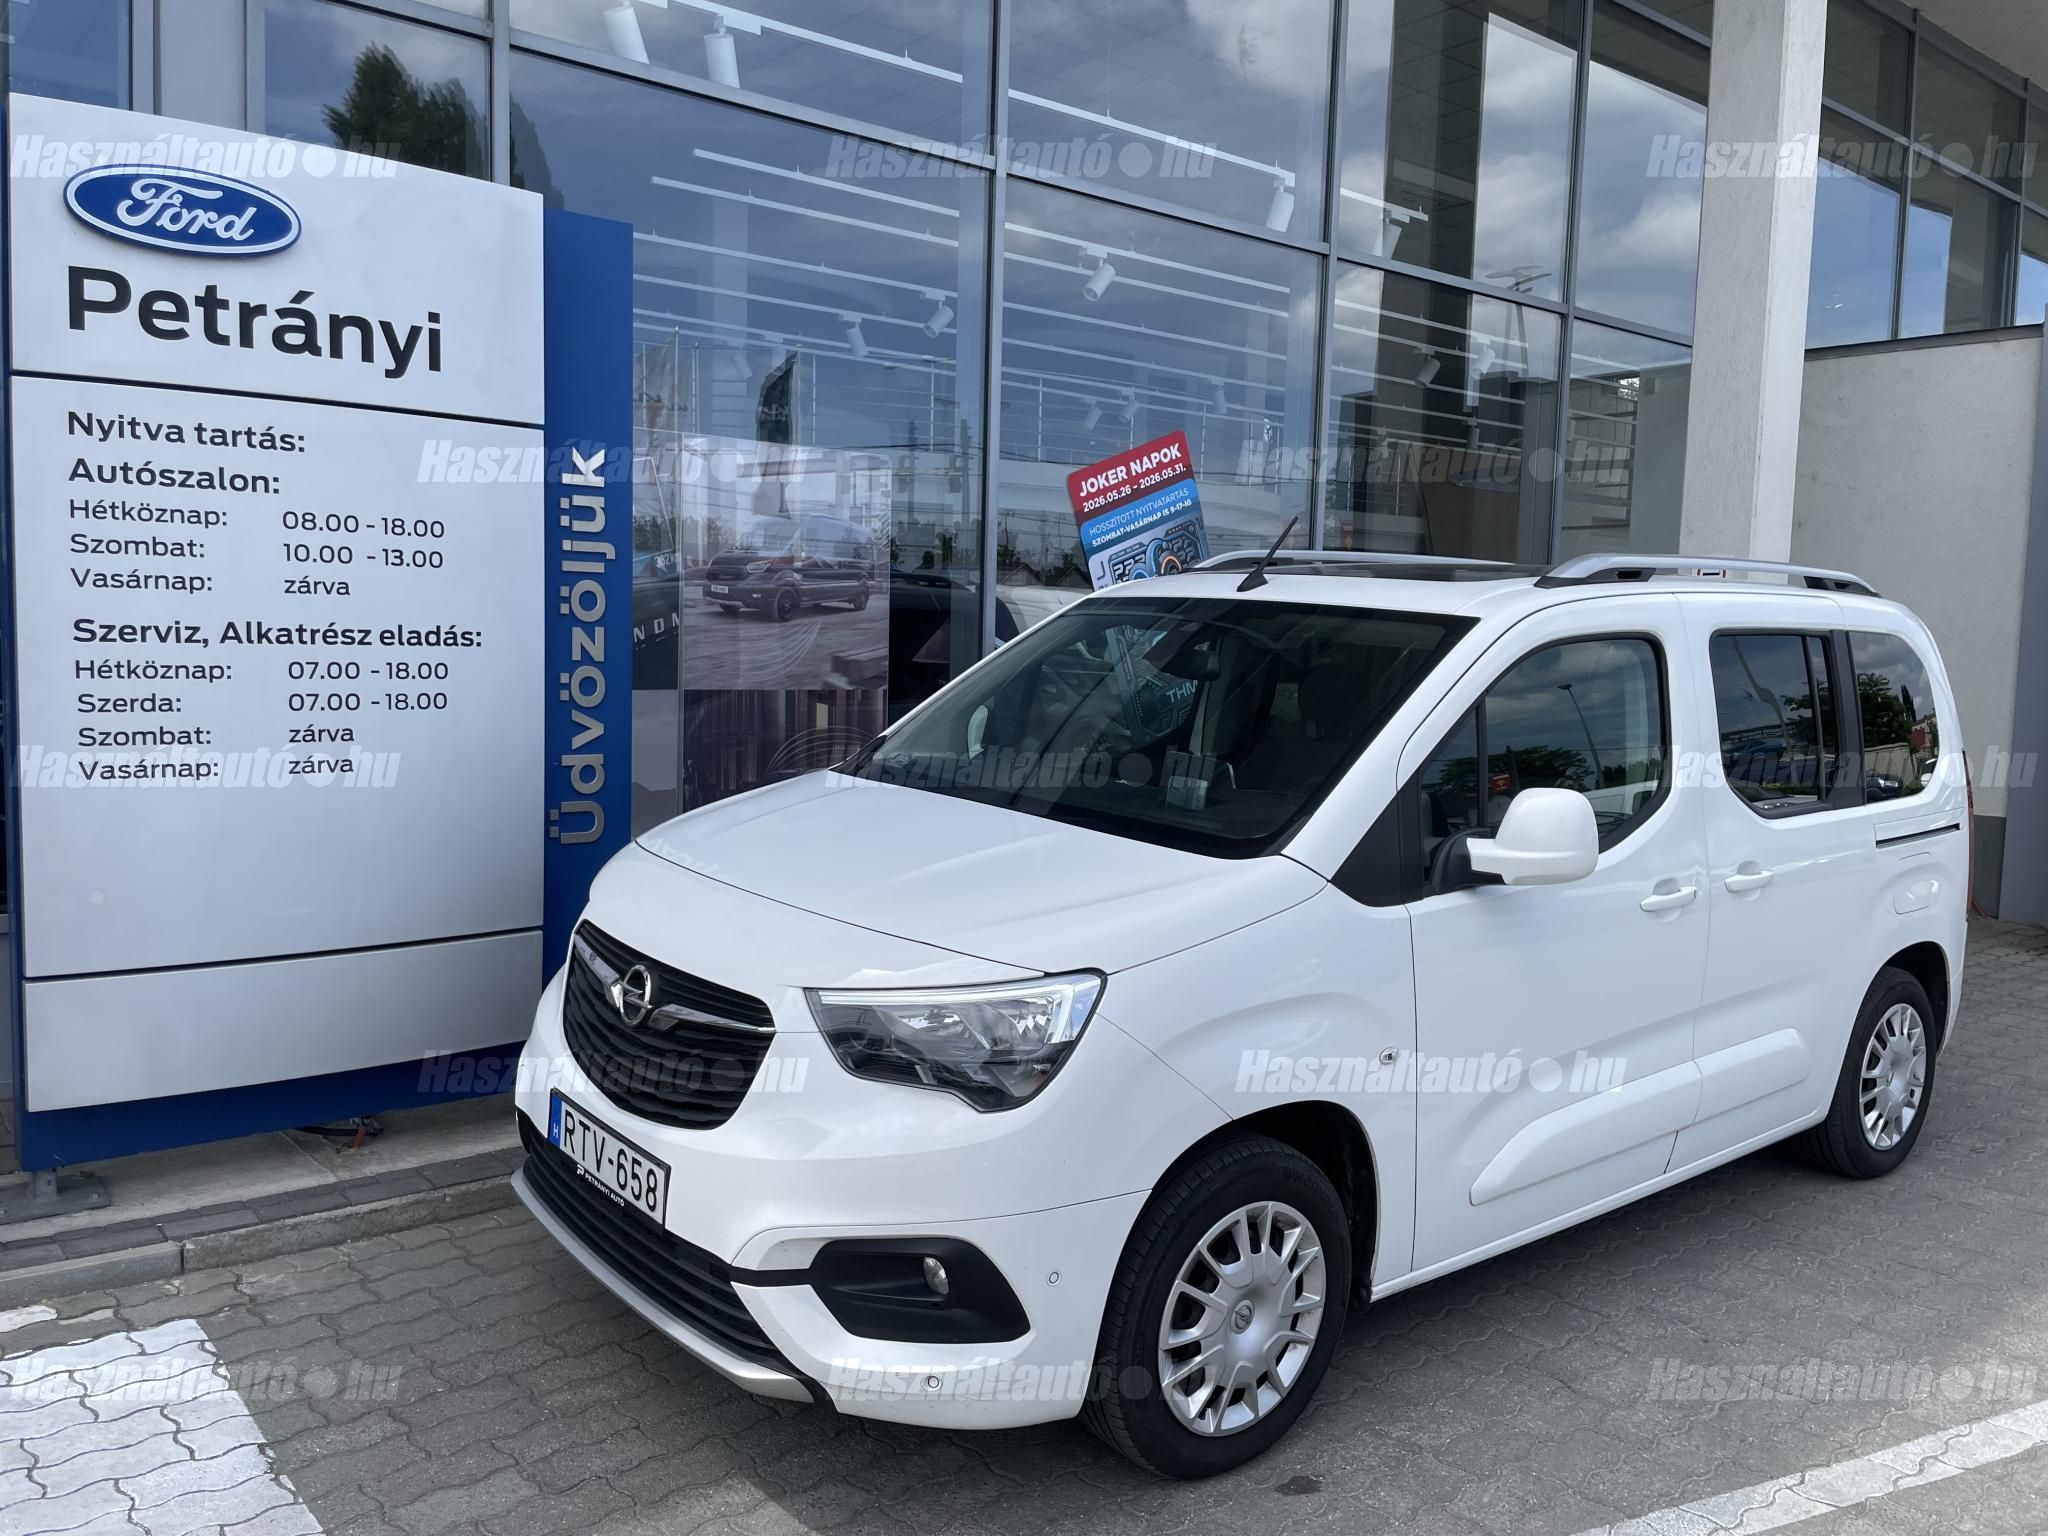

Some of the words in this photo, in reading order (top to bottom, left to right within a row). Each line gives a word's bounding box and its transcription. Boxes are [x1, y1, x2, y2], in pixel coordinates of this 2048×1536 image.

[117, 177, 258, 242] Ford
[67, 265, 443, 379] Petrányi
[67, 411, 186, 444] Nyitva
[193, 422, 305, 453] tartás:
[68, 457, 281, 494] Autószalon:
[1080, 466, 1127, 497] JOKER
[1130, 443, 1182, 477] NAPOK
[1083, 484, 1131, 513] 2026.05.26
[1139, 463, 1187, 489] 2026.05.31.
[68, 498, 228, 529] Hétköznap:
[282, 510, 360, 534] 08.00
[381, 517, 445, 539] 18.00
[1089, 510, 1135, 537] HOSSZÍTOTT
[1135, 488, 1189, 517] NYITVATARTÁS
[70, 533, 205, 559] Szombat:
[283, 543, 353, 565] 10.00
[381, 548, 444, 569] 13.00
[70, 567, 214, 595] Vasárnap:
[283, 575, 351, 597] zárva
[72, 618, 209, 649] Szerviz,
[219, 620, 373, 647] Alkatrész
[379, 624, 482, 648] eladás:
[549, 446, 616, 845] Üdvözöljük
[75, 658, 232, 684] Hétköznap:
[288, 661, 361, 681] 07.00
[385, 661, 449, 681] 18.00
[77, 692, 182, 714] Szerda:
[288, 692, 361, 712] 07.00
[385, 692, 449, 712] 18.00
[78, 724, 212, 747] Szombat:
[288, 723, 355, 744] zárva
[78, 758, 219, 783] Vasárnap:
[288, 754, 355, 776] zárva
[552, 1122, 559, 1135] H
[563, 1108, 658, 1213] RTV-658
